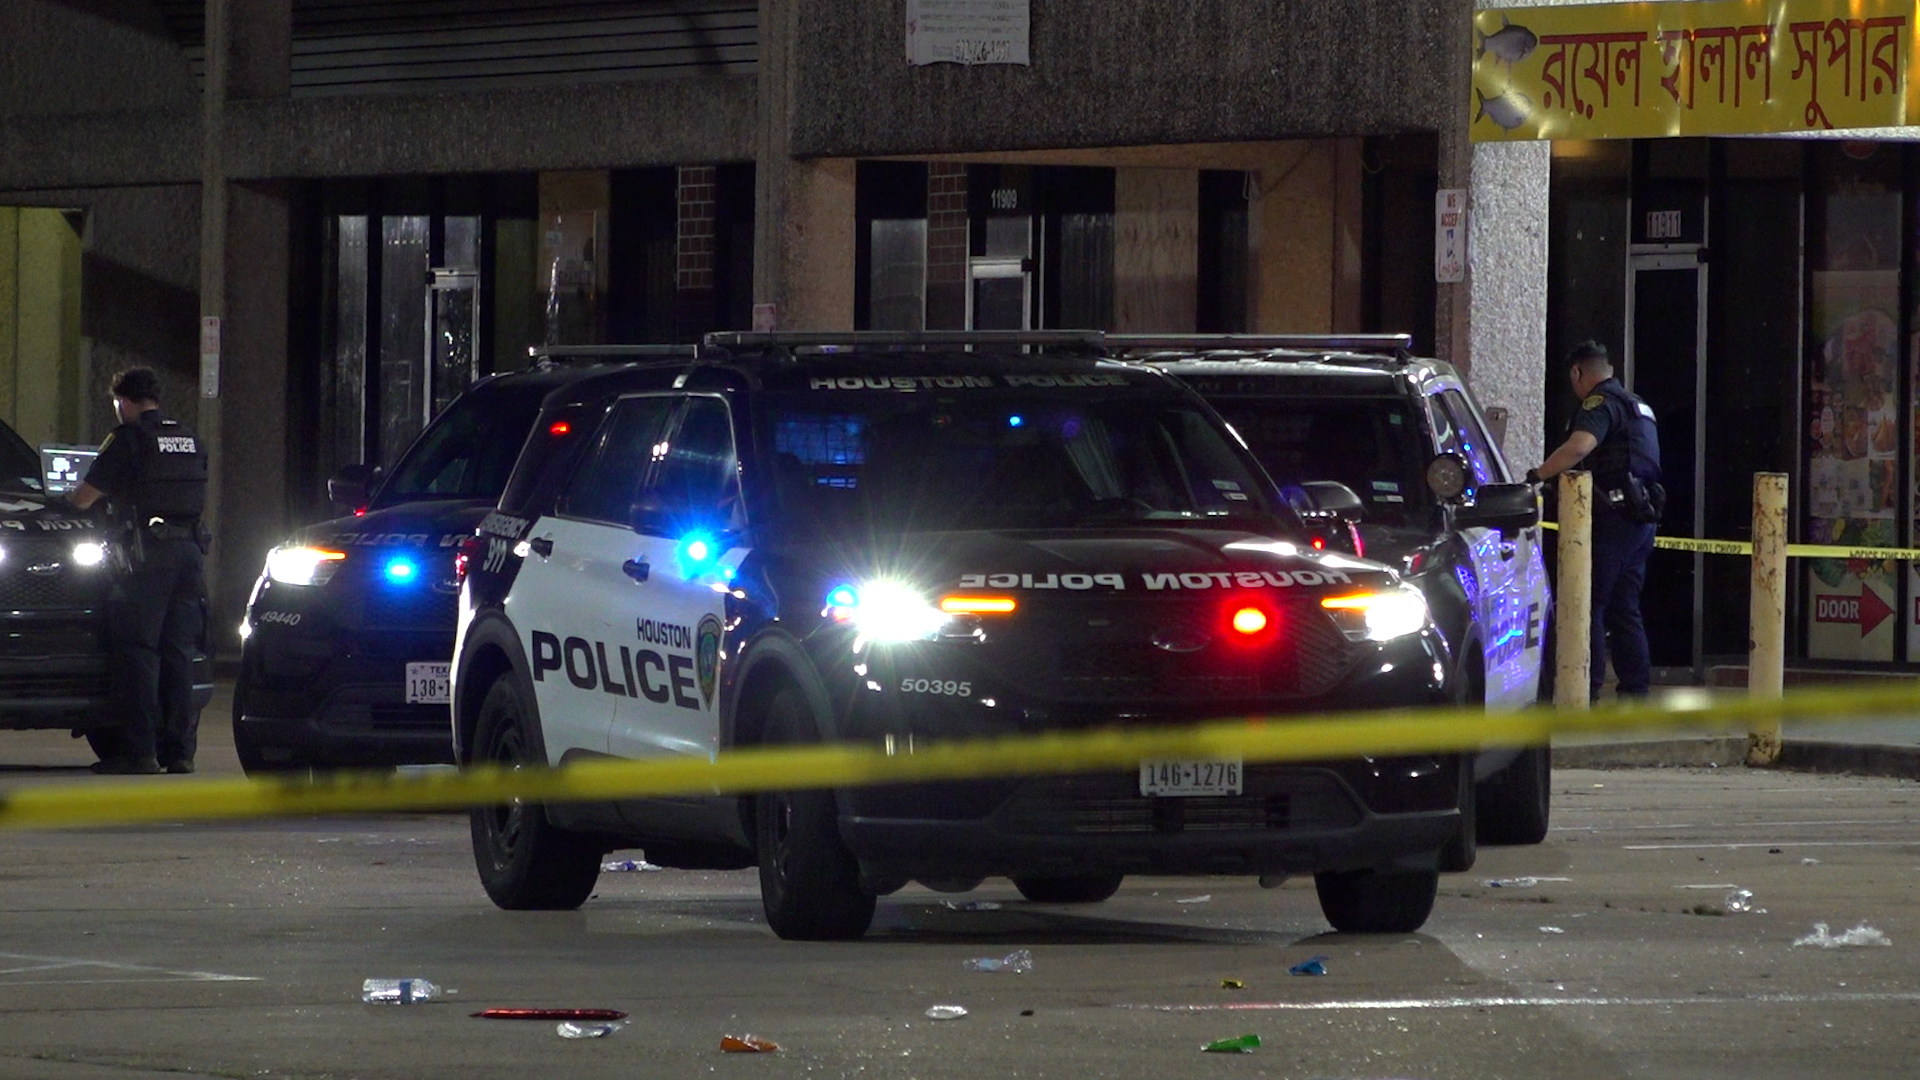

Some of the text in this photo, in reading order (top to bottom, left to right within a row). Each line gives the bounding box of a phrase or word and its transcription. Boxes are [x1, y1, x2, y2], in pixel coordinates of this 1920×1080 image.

[1540, 16, 1907, 129] রয়েল হালাল সুপার
[810, 375, 1130, 390] HOUSTON POLICE
[159, 443, 196, 453] POLICE
[483, 537, 507, 573] 911
[260, 610, 301, 626] 49440
[1818, 600, 1860, 619] DOOR
[636, 617, 692, 649] HOUSTON
[431, 666, 448, 674] TEX
[531, 629, 700, 711] POLICE
[900, 678, 972, 697] 50395
